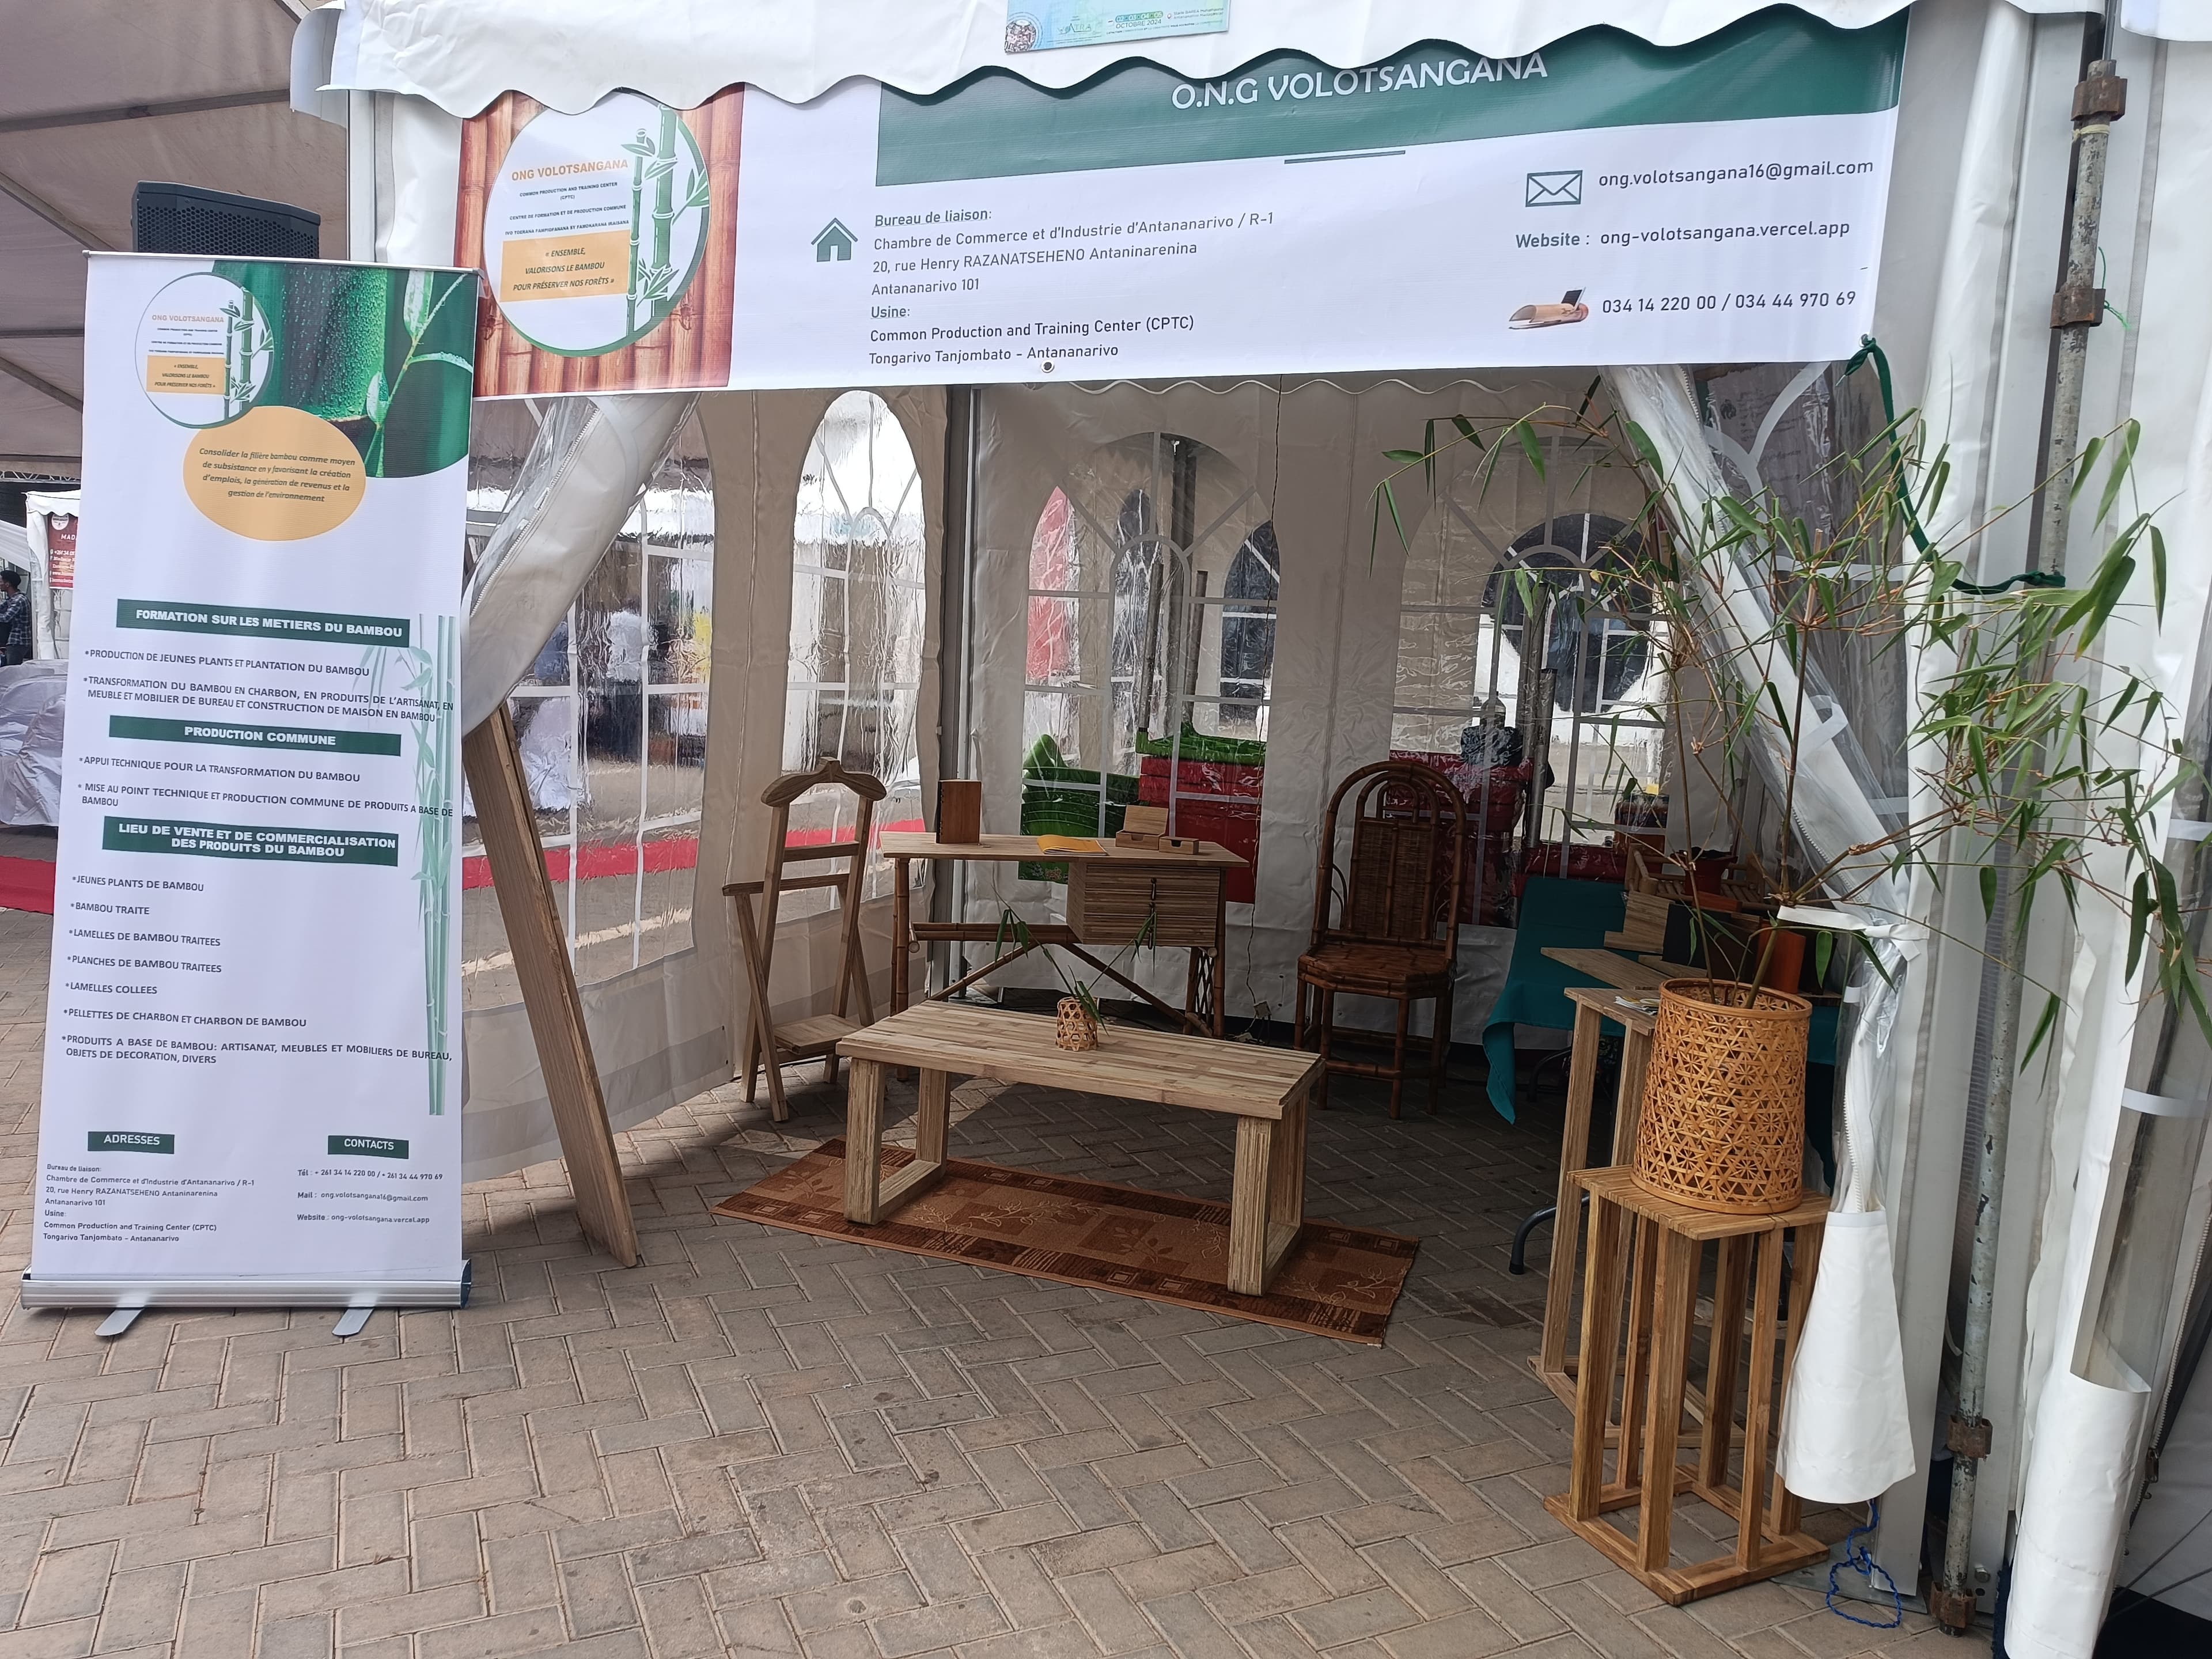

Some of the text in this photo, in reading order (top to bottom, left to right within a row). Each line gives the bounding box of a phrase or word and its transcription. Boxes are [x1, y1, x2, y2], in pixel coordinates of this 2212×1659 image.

[1116, 21, 1145, 29] OCTOBRE
[1172, 52, 1548, 109] O.N.G VOLOTSANGANA
[512, 160, 628, 181] ONG VOLOTSANGANA
[1599, 161, 1873, 188] ong.volotsangana16@gmail.com
[875, 209, 991, 226] Bureau de liaison:
[874, 236, 931, 249] Chambre
[936, 234, 950, 246] de
[956, 232, 1027, 245] Commerce
[1032, 228, 1044, 240] et
[1050, 223, 1122, 238] d'Industrie
[1127, 216, 1233, 233] d'Antananarivo
[1249, 212, 1272, 225] R-1
[1516, 232, 1580, 248] Website
[1601, 221, 1849, 247] ong-volotsangana.vercel.app
[551, 247, 585, 257] ENSEMBLE,
[873, 242, 1196, 274] 20, rue Henry RAZANATSEHENO Antaninarenina
[525, 265, 565, 274] VALORISONS
[574, 262, 605, 271] BAMBOU
[532, 281, 568, 289] PRÉSERVER
[585, 276, 609, 286] FORÊTS
[872, 278, 978, 295] Antananarivo 101
[1603, 298, 1632, 313] 034
[1638, 298, 1654, 312] 14
[1661, 296, 1690, 310] 220
[1697, 296, 1715, 309] 00
[1736, 294, 1765, 308] 034
[1772, 294, 1792, 307] 44
[1800, 293, 1828, 306] 970
[1836, 291, 1855, 305] 69
[872, 305, 910, 319] Usine:
[870, 315, 1193, 342] Common Production and Training Center (CPTC)
[869, 351, 930, 366] Tongarivo
[935, 349, 1011, 364] Tanjombato
[1027, 344, 1118, 358] Antananarivo
[199, 448, 240, 457] Consolider
[248, 452, 269, 460] filière
[270, 452, 297, 460] bambou
[213, 462, 257, 472] subsistance
[271, 465, 308, 474] favorisant
[319, 469, 351, 478] création
[300, 482, 332, 490] revenus
[136, 609, 402, 637] FORMATION SUR LES METIERS DU BAMBOU
[90, 649, 369, 676] PRODUCTION DE JEUNES PLANTS ET PLANTATION DU BAMBOU
[184, 726, 336, 745] PRODUCTION COMMUNE
[119, 823, 395, 848] LIEU DE VENTE ET DE COMMERCIALISATION
[172, 838, 344, 857] DES PRODUITS DU BAMBOU
[76, 875, 203, 891] JEUNES PLANTS DE BAMBOU
[75, 902, 149, 915] BAMBOU TRAITE
[74, 929, 114, 940] LAMELLES
[133, 933, 179, 942] BAMBOU
[181, 935, 220, 946] TRAITEES
[70, 982, 157, 994] LAMELLES COLLEES
[66, 1048, 97, 1058] OBJETS
[116, 1051, 179, 1063] DECORATION,
[182, 1055, 216, 1063] DIVERS
[103, 1134, 160, 1145] ADRESSES
[344, 1138, 394, 1150] CONTACTS
[45, 1198, 92, 1206] Antananarivo
[134, 1224, 164, 1232] Training
